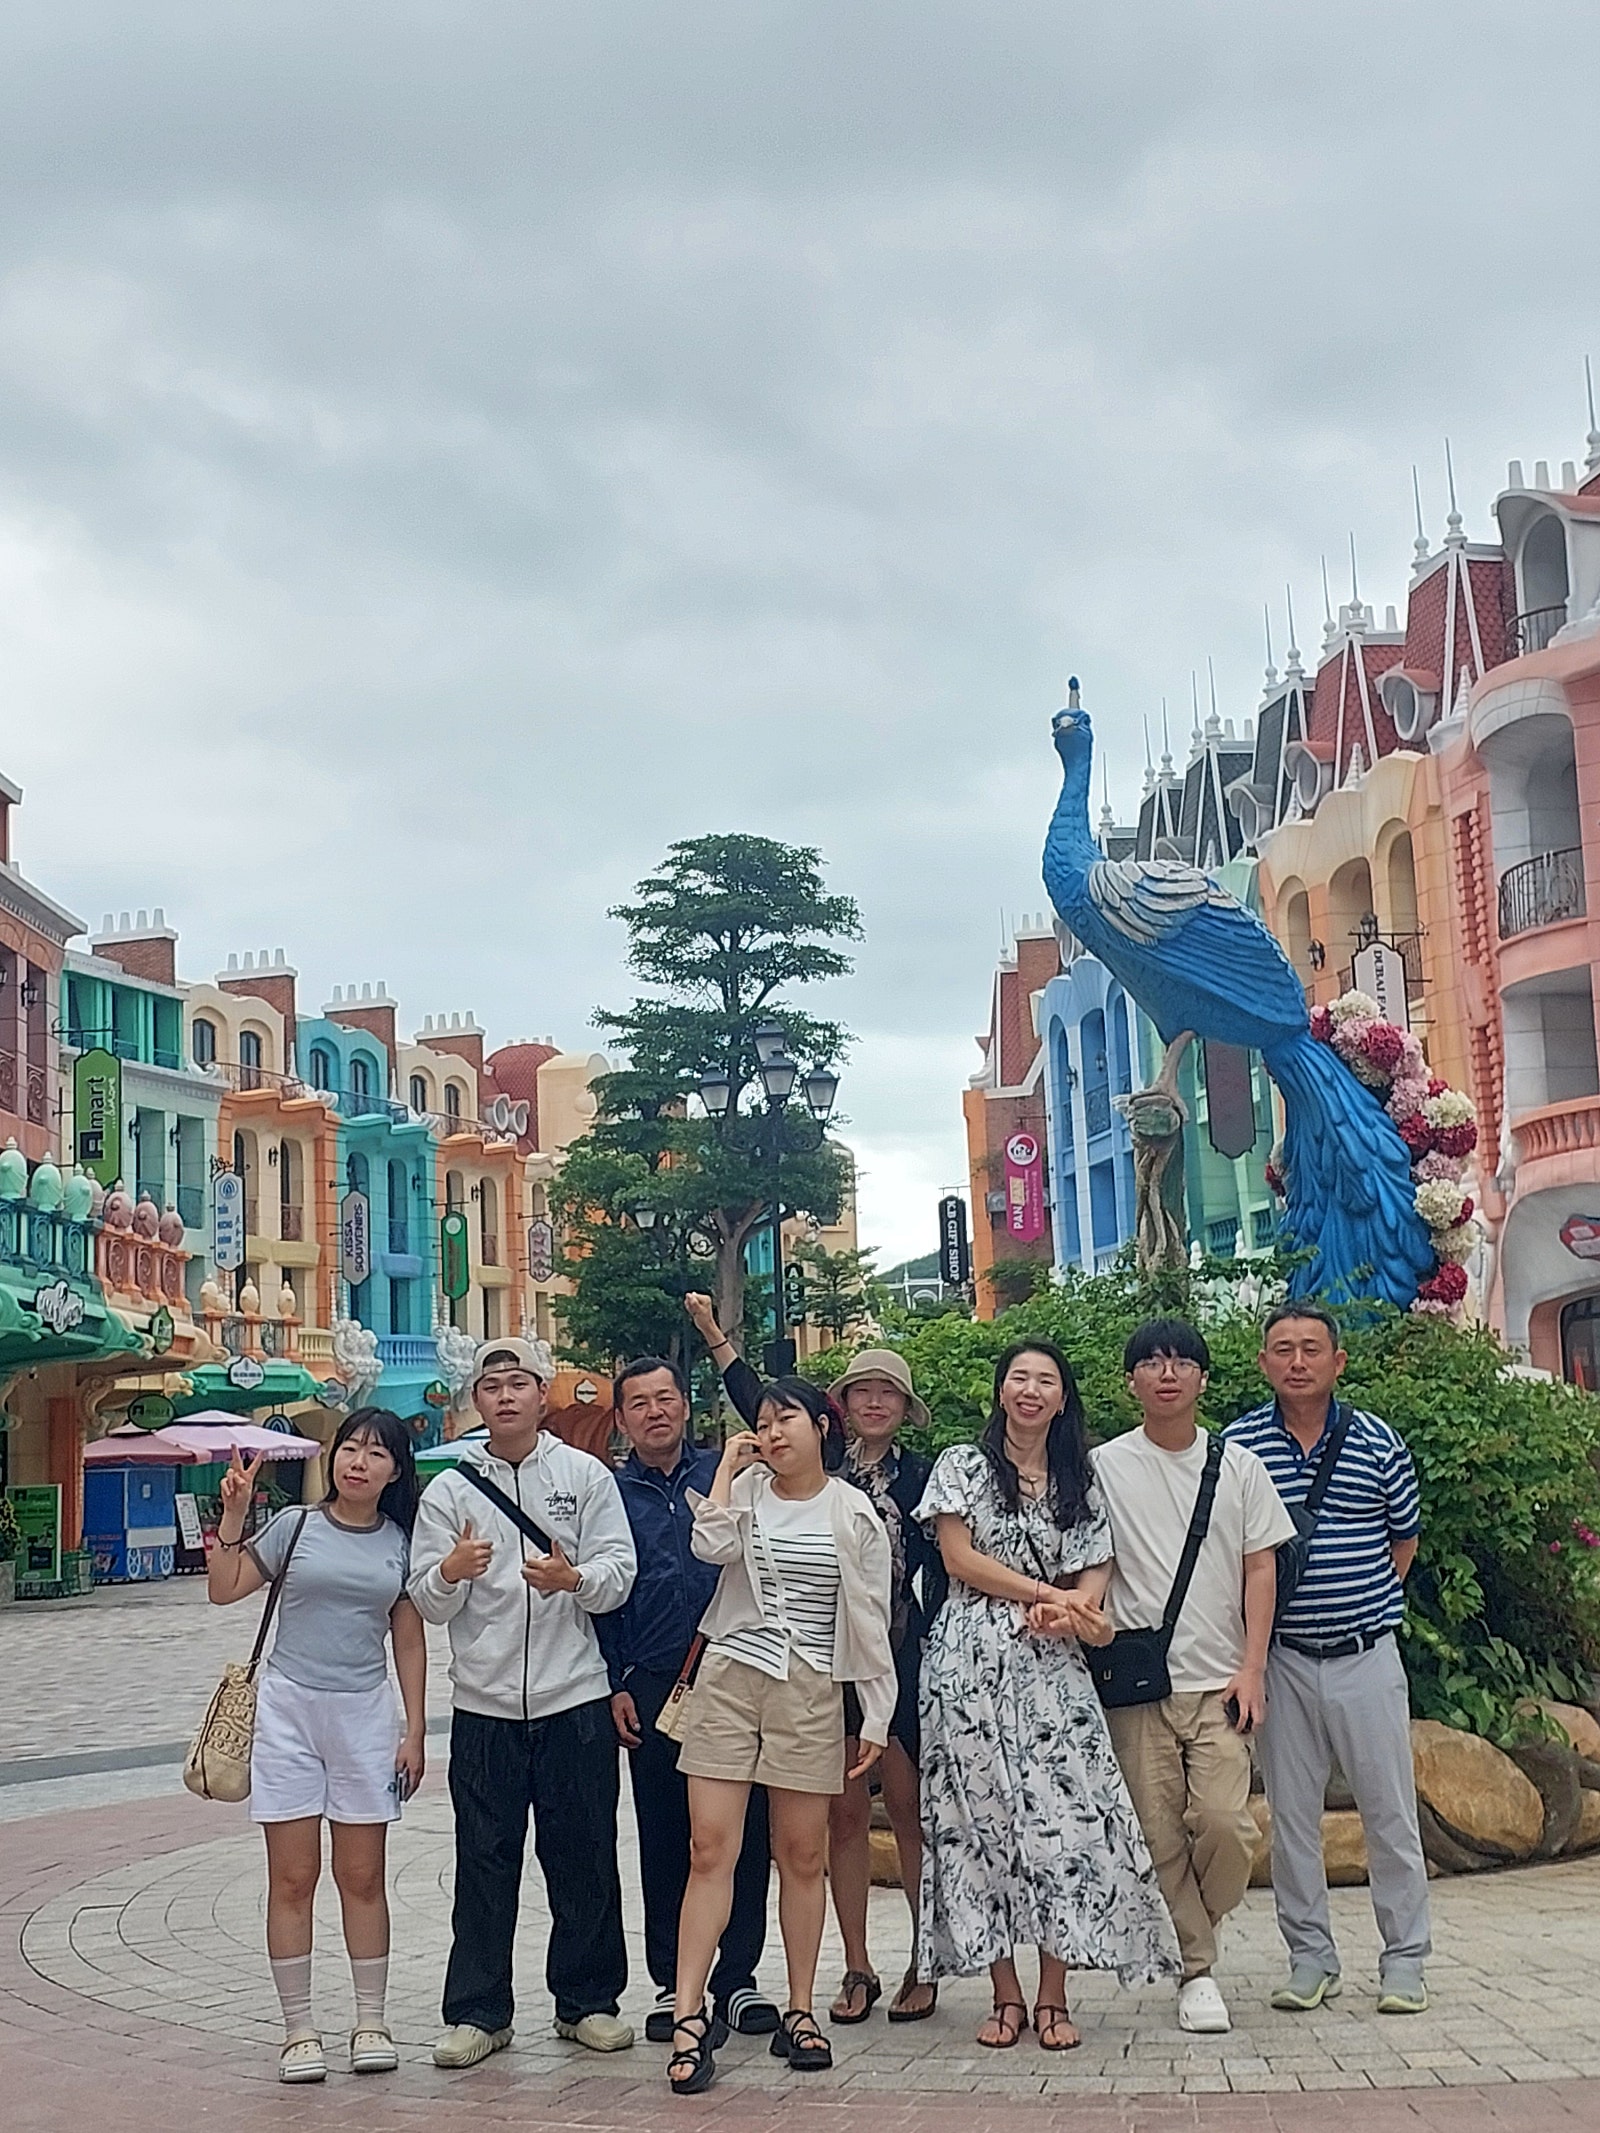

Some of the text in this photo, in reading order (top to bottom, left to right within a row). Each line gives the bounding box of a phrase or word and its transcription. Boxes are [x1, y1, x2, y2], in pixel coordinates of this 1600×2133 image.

[1374, 950, 1385, 992] DUBAI
[80, 1076, 104, 1160] Amart
[947, 1220, 958, 1248] GIFT
[1013, 1206, 1024, 1230] PAN
[344, 1219, 354, 1258] KISSA
[354, 1203, 365, 1273] SOUVENIRS
[948, 1249, 960, 1281] SHOP
